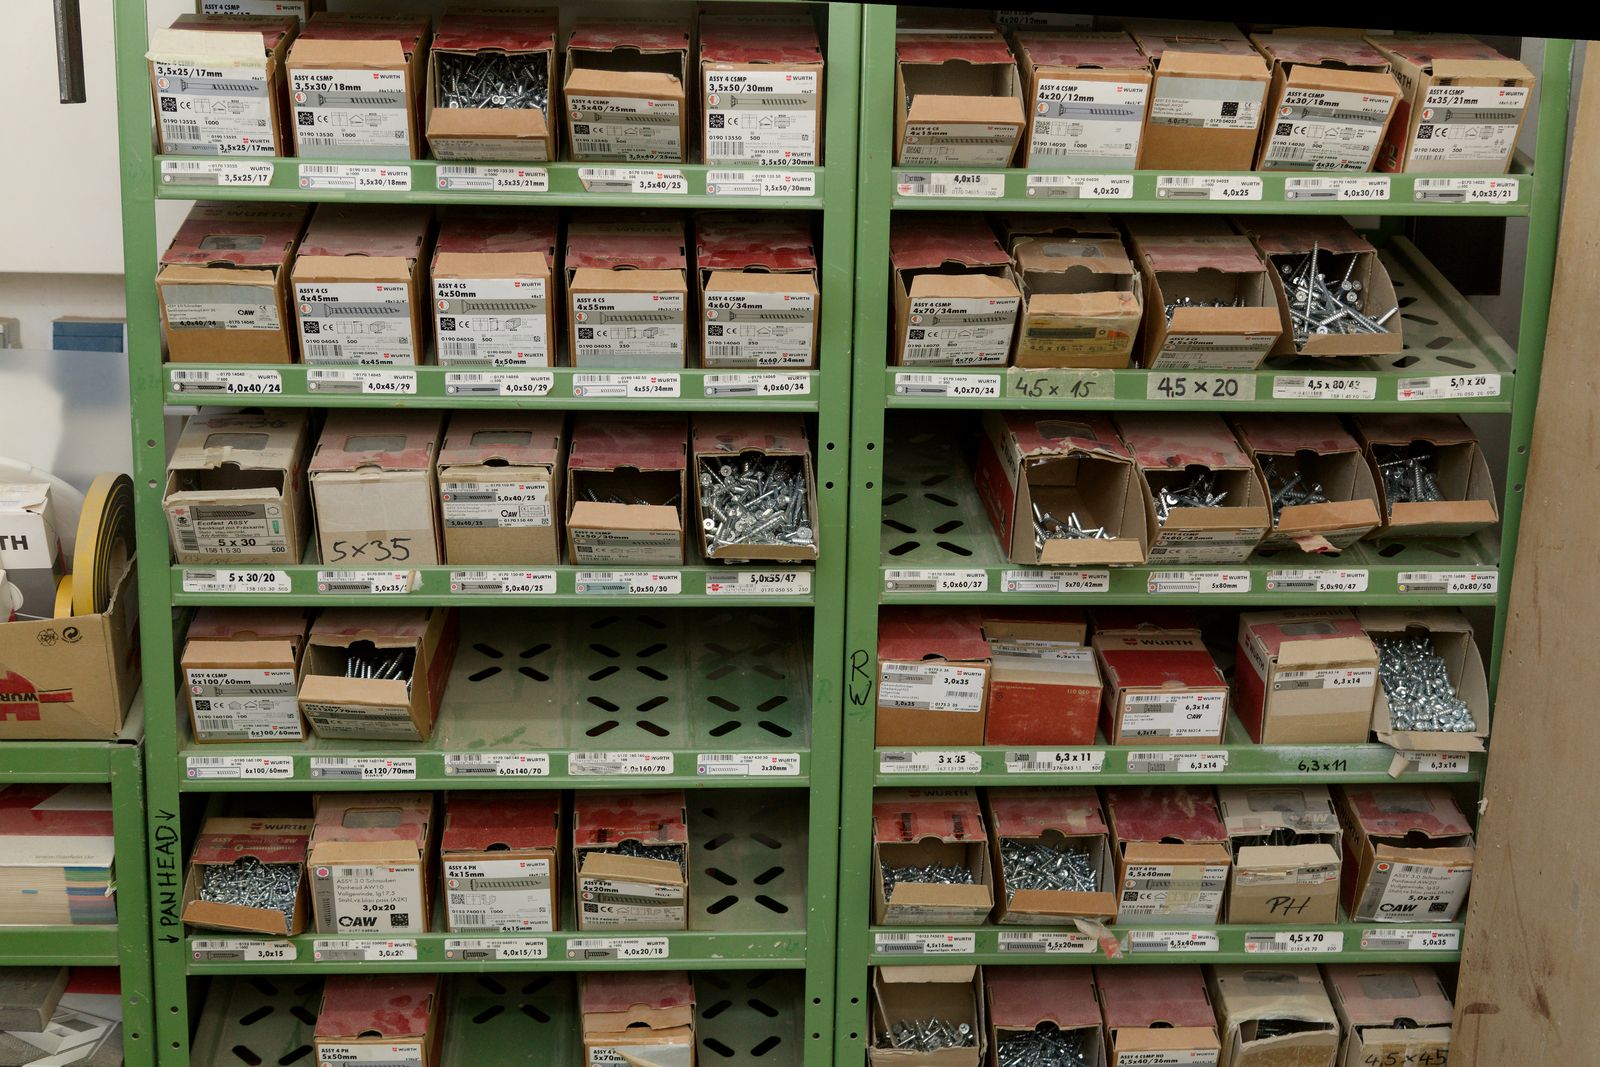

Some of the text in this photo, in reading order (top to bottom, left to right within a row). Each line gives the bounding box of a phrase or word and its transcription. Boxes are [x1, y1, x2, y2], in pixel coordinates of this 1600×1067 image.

[158, 67, 223, 78] 3,5x25/17mm
[295, 82, 362, 92] 3,5x30/18mm
[709, 84, 773, 92] 3,5x50/30mm
[1040, 84, 1055, 92] ASSY
[1039, 93, 1094, 102] 4x20/12mm
[1426, 96, 1478, 106] 4x35/21mm
[1285, 98, 1340, 108] 4x30/18mm
[572, 104, 636, 113] 3,5x40/25mm
[219, 144, 274, 153] 3,5x25/17mm
[761, 158, 814, 167] 3,5x50/30mm
[224, 174, 268, 183] 3,5x25/17
[359, 178, 408, 187] 3,5x30/18mm
[954, 175, 981, 184] 4,0x15
[497, 179, 545, 188] 3,5x35/21mm
[639, 181, 681, 190] 3,5x40/25
[764, 184, 811, 193] 3,5x50/30mm
[1093, 187, 1120, 196] 4,0x20
[1223, 188, 1249, 197] 4,0x25
[1344, 189, 1384, 198] 4,0x30/18
[1472, 189, 1512, 198] 4,0x35/21
[300, 295, 339, 303] 4x45mm
[438, 290, 476, 299] 4x50mm
[577, 303, 615, 311] 4x55mm
[708, 302, 763, 310] 4x60/34mm
[912, 307, 967, 315] 4x70/34mm
[368, 382, 410, 391] 4,0x45/29
[1308, 380, 1322, 390] 4,5
[1450, 377, 1464, 388] 5,0
[1475, 376, 1486, 386] 20
[227, 383, 281, 393] 4,0x40/24
[506, 384, 548, 392] 4,0x50/29
[634, 385, 674, 393] 4x55/34mm
[763, 383, 804, 392] 4,0x60/34
[954, 386, 994, 394] 4,0x70/34
[1070, 379, 1096, 398] 15
[1157, 377, 1186, 397] 4,5
[1213, 378, 1239, 397] 20
[497, 494, 536, 503] 5,0x40/25
[218, 538, 226, 547] 5
[240, 538, 256, 547] 30
[331, 538, 412, 563] 5x35
[229, 574, 236, 582] 5
[246, 573, 276, 583] 30/20
[750, 574, 796, 583] 5,0x55/47
[505, 584, 544, 593] 5,0x40/25
[630, 585, 668, 593] 5,0x50/30
[942, 580, 982, 589] 5,0x60/37
[1065, 581, 1103, 589] 5x70/42mm
[1211, 582, 1238, 590] 5x80mm
[1320, 583, 1356, 592] 5,0x90/47
[1452, 583, 1492, 591] 6,0x80/50
[192, 678, 251, 686] 6x100/60mm
[944, 677, 969, 686] 3,0x35
[938, 755, 944, 764] 3
[1055, 753, 1070, 763] 6,3
[1081, 753, 1092, 762] 11
[245, 767, 289, 775] 6x100/60mm
[364, 767, 415, 776] 6x120/70mm
[499, 767, 542, 776] 6,0x140/70
[449, 870, 485, 878] 4x15mm
[362, 904, 396, 912] 3,0x20
[1289, 934, 1303, 944] 4,5
[1313, 934, 1324, 942] 70
[1422, 938, 1446, 946] 5,0x35
[1047, 942, 1084, 950] 4,5x20mm
[258, 950, 284, 958] 3,0x15
[503, 949, 542, 957] 4,0x15/13
[624, 948, 663, 956] 4,0x20/18
[1119, 1058, 1178, 1066] 4,5x40/26mm
